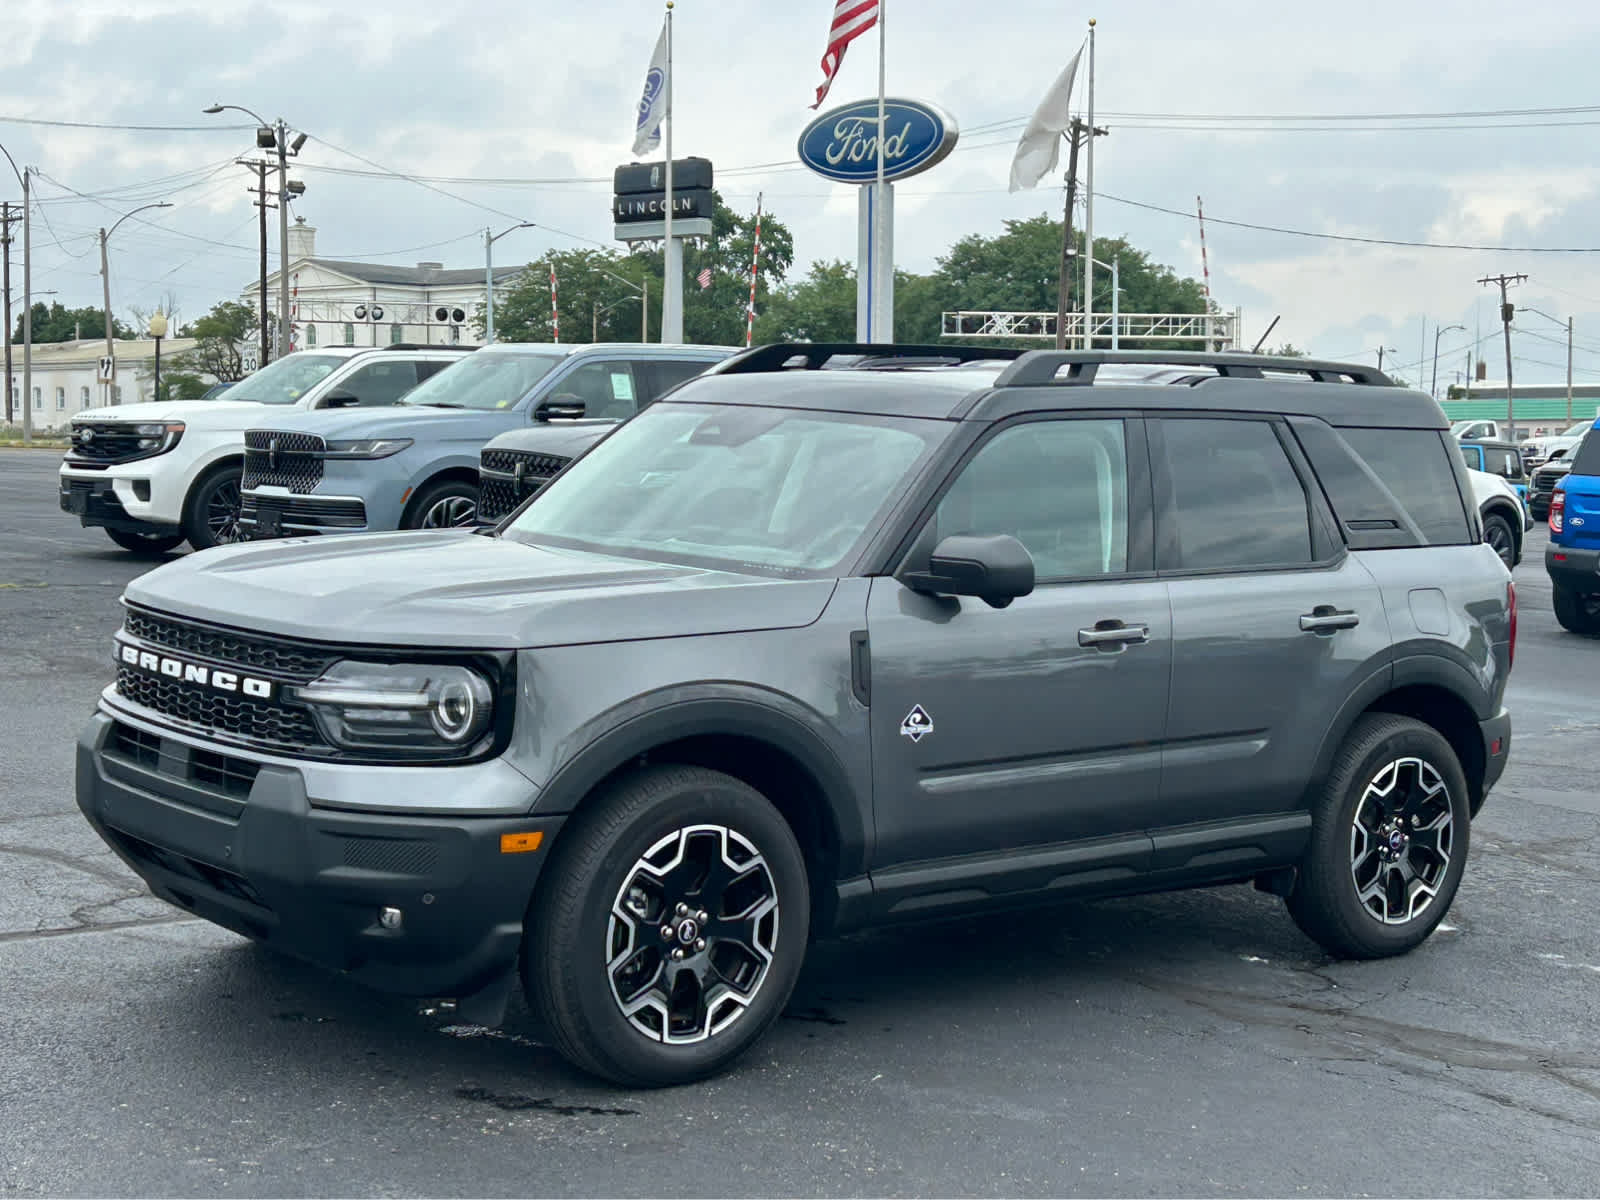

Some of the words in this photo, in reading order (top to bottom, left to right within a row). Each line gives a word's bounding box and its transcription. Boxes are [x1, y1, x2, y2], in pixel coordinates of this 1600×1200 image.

[825, 114, 911, 165] Ford
[243, 358, 257, 371] 30
[121, 646, 271, 698] BRONCO
